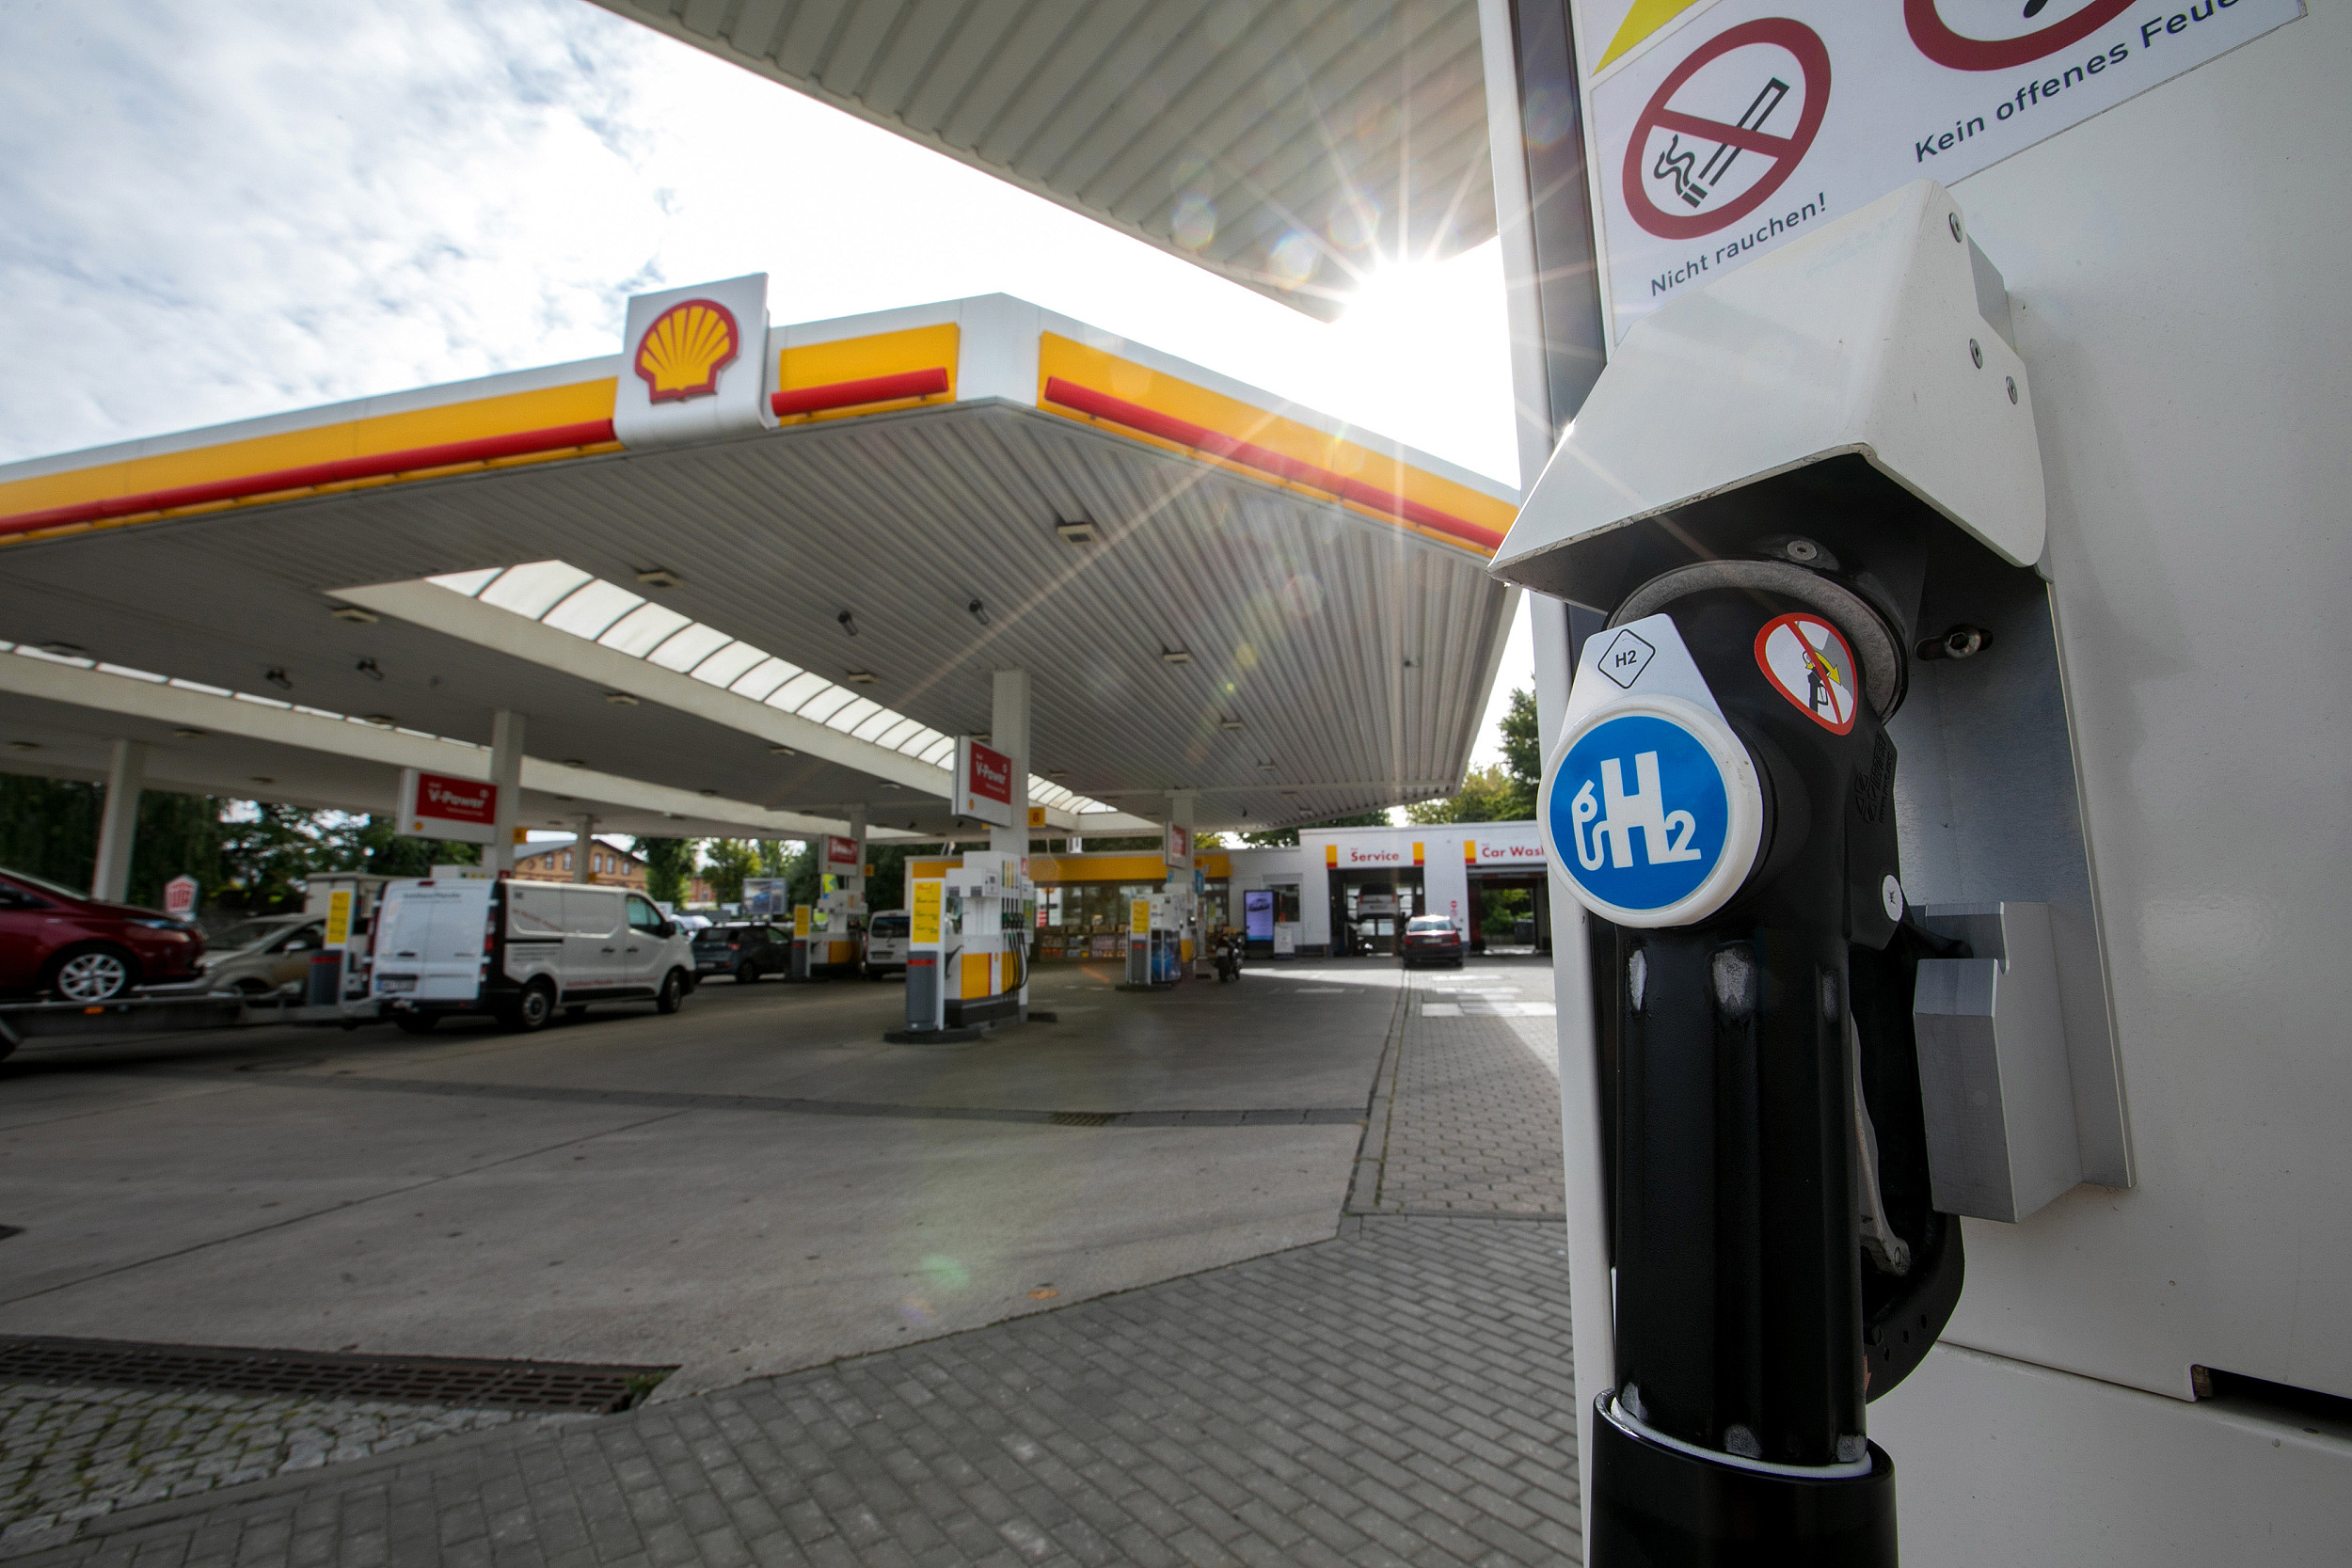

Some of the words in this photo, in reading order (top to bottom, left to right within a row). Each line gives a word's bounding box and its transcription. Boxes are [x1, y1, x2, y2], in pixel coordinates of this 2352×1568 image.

[1915, 117, 1985, 162] Kein
[1995, 42, 2129, 121] offenes
[1651, 255, 1708, 296] Nicht
[1715, 192, 1826, 264] rauchen!
[1615, 650, 1637, 667] H2
[976, 762, 1007, 784] V-Power
[428, 788, 485, 808] V-Power
[1600, 751, 1702, 868] H2
[1350, 849, 1400, 863] Service
[1482, 847, 1504, 858] Car
